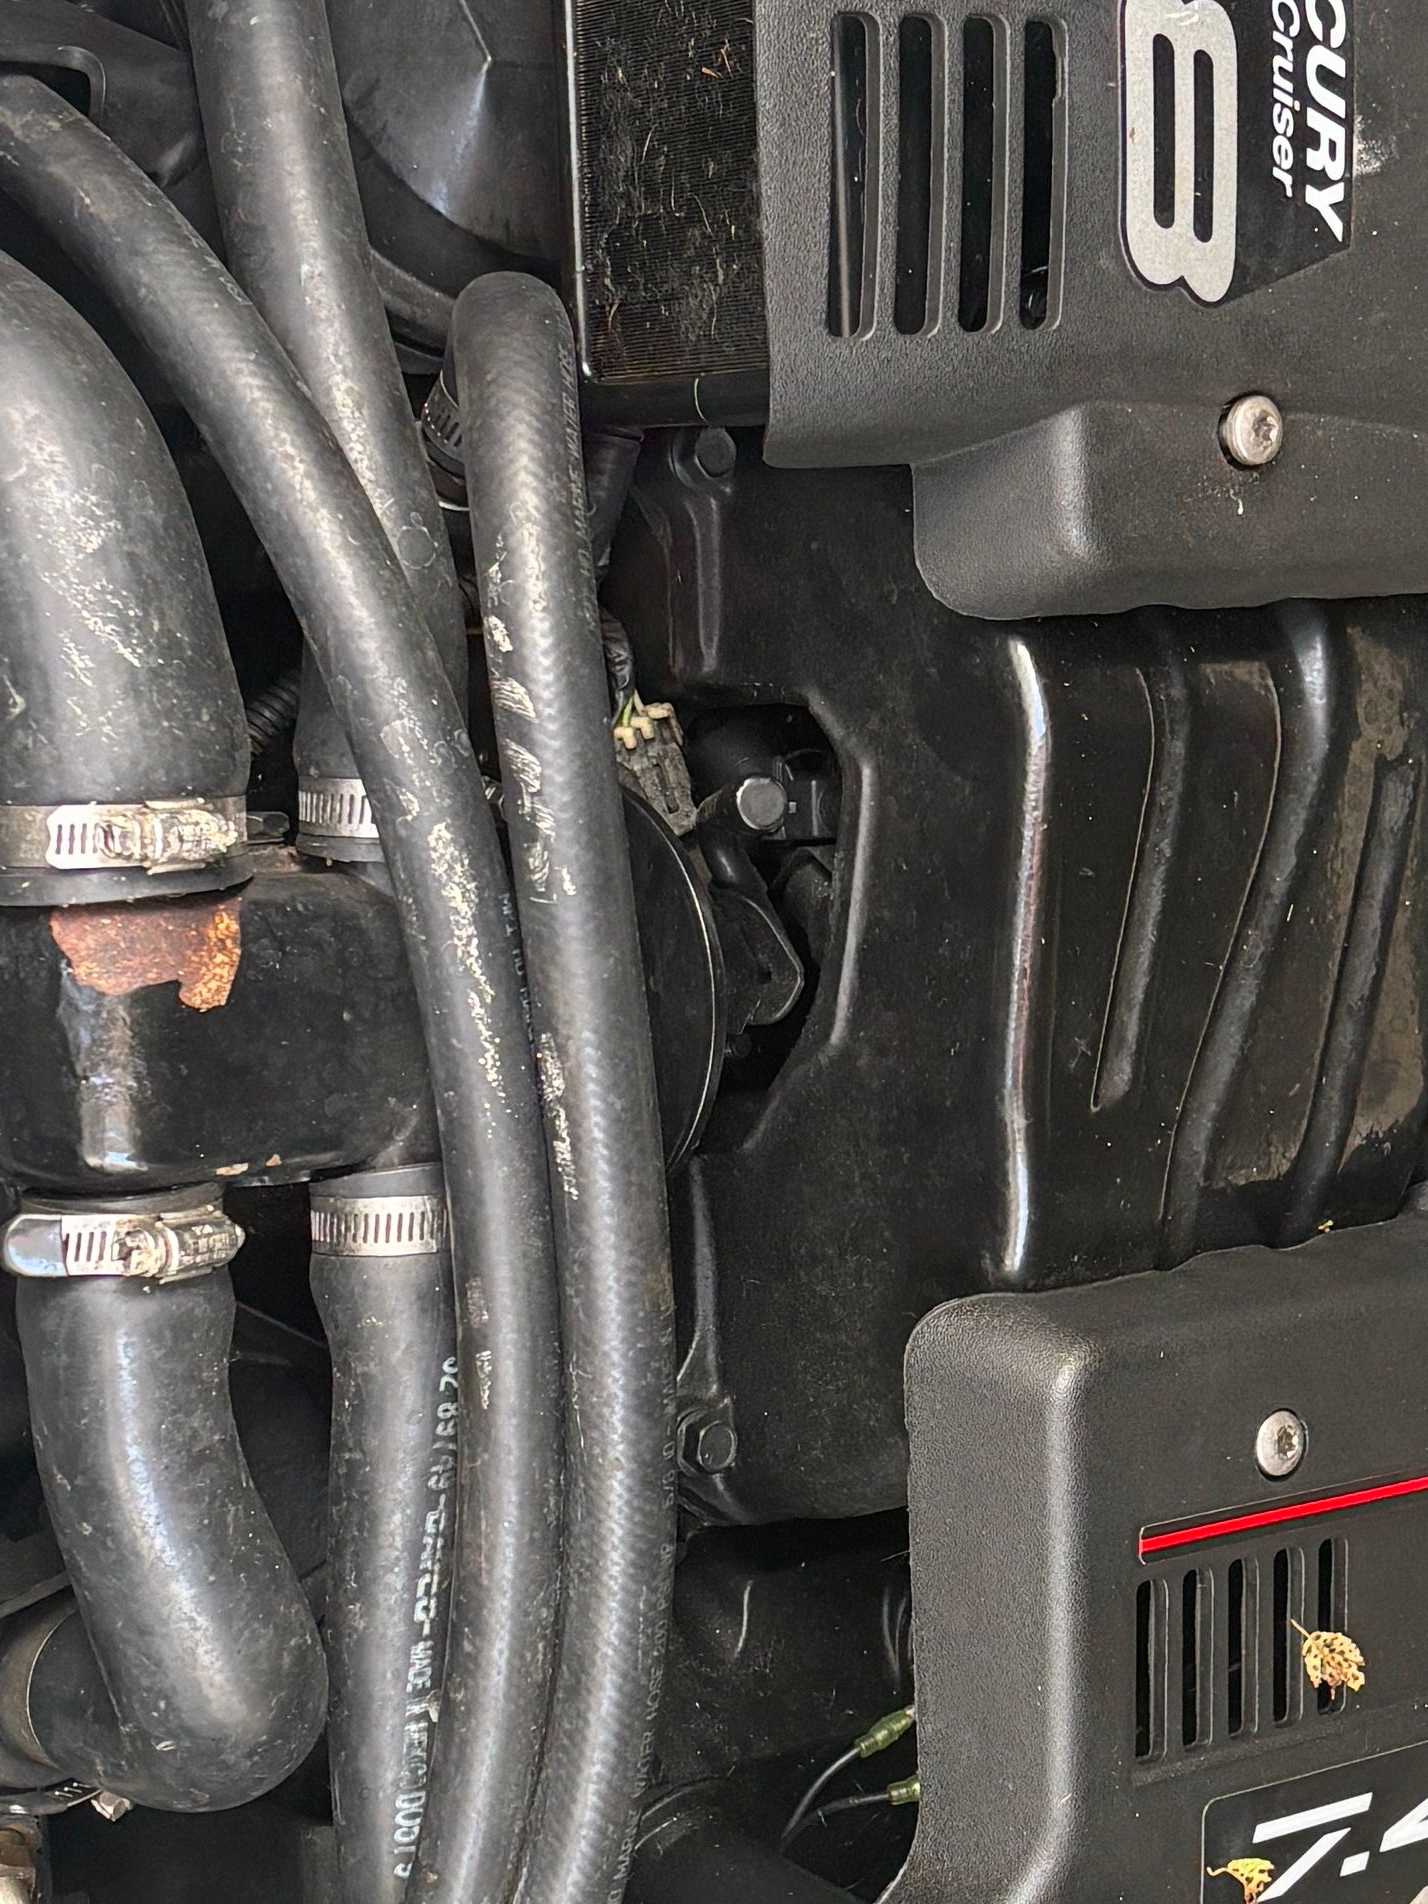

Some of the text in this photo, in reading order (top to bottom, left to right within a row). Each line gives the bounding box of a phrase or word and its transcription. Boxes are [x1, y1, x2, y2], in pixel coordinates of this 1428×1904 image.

[406, 1639, 434, 1692] MADE
[642, 1664, 666, 1721] HOSE
[630, 1729, 656, 1799] WATER
[612, 1805, 642, 1881] MARINE
